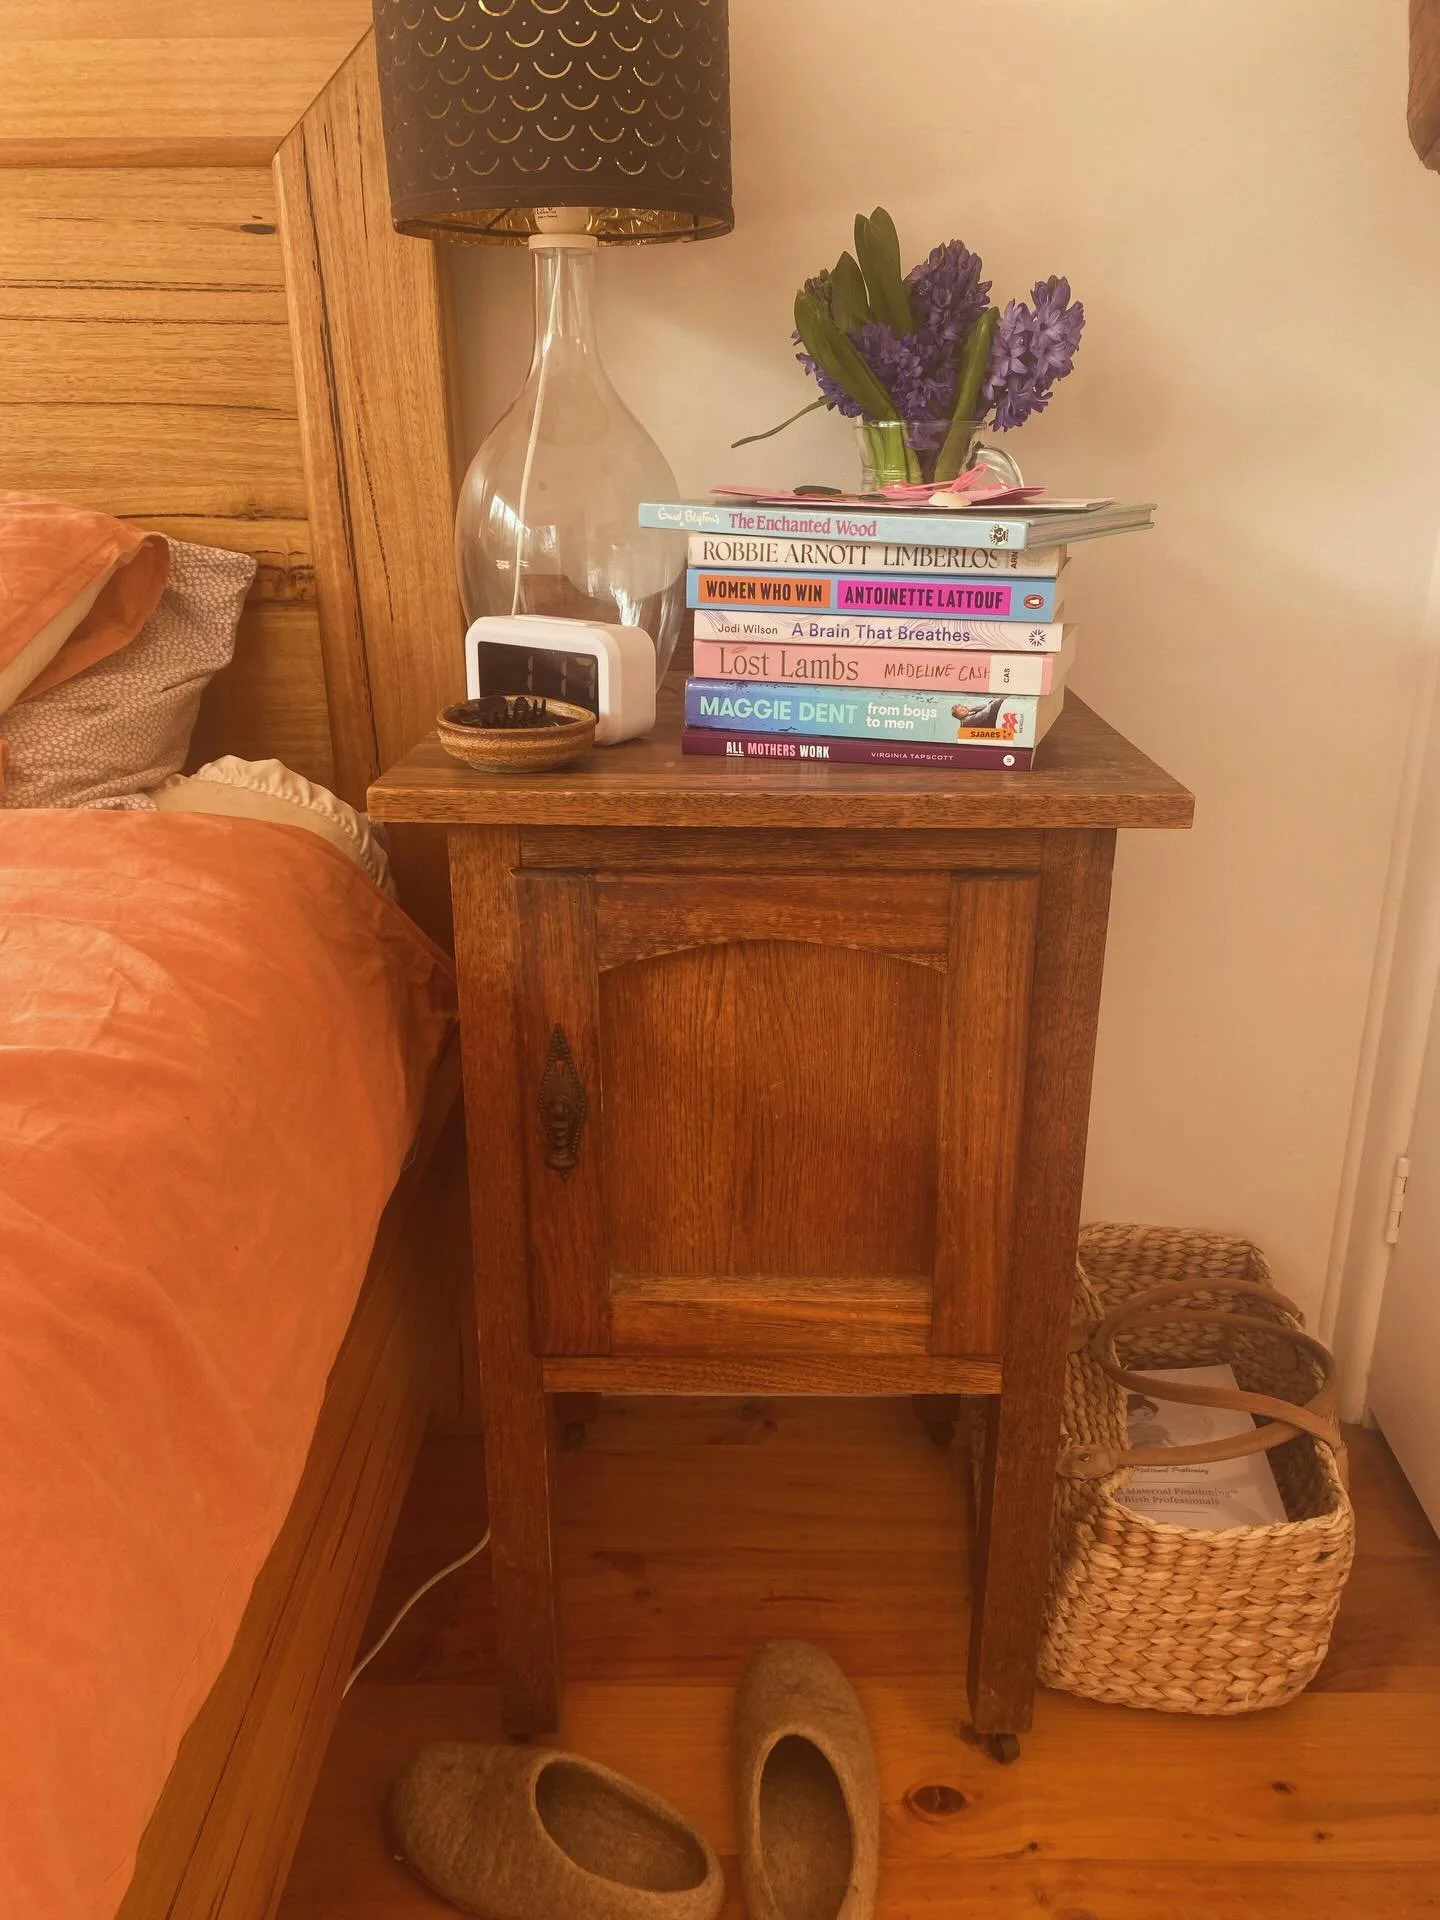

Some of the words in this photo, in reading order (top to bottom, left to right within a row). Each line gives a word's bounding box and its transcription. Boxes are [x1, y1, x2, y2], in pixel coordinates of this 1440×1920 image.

[729, 513, 754, 529] The
[756, 515, 831, 534] Enchanted
[836, 520, 877, 537] Wood
[703, 541, 779, 562] ROBBIE
[784, 543, 871, 565] ARNOTT
[884, 546, 1009, 569] LIMBERLOS
[1010, 551, 1018, 569] ARN
[706, 580, 756, 599] WOMEN
[761, 583, 791, 601] WHO
[795, 584, 822, 602] WIN
[845, 586, 933, 607] ANTOINETTE
[937, 589, 1003, 609] LATTOUF
[718, 624, 740, 633] Jodi
[744, 624, 778, 635] Wilson
[792, 623, 804, 636] A
[809, 623, 850, 638] Brain
[855, 624, 892, 640] That
[898, 626, 970, 642] Breathes
[720, 647, 770, 676] Lost
[781, 650, 859, 681] Lambs
[884, 664, 955, 679] MADELINE
[700, 696, 792, 720] MAGGIE
[799, 702, 858, 724] DENT
[867, 702, 901, 715] from
[903, 704, 938, 721] boys
[866, 716, 880, 728] to
[884, 718, 914, 730] men
[726, 741, 744, 756] ALL
[748, 742, 796, 757] MOTHERS
[799, 744, 830, 758] WORK
[910, 753, 954, 761] TAPSCOTT
